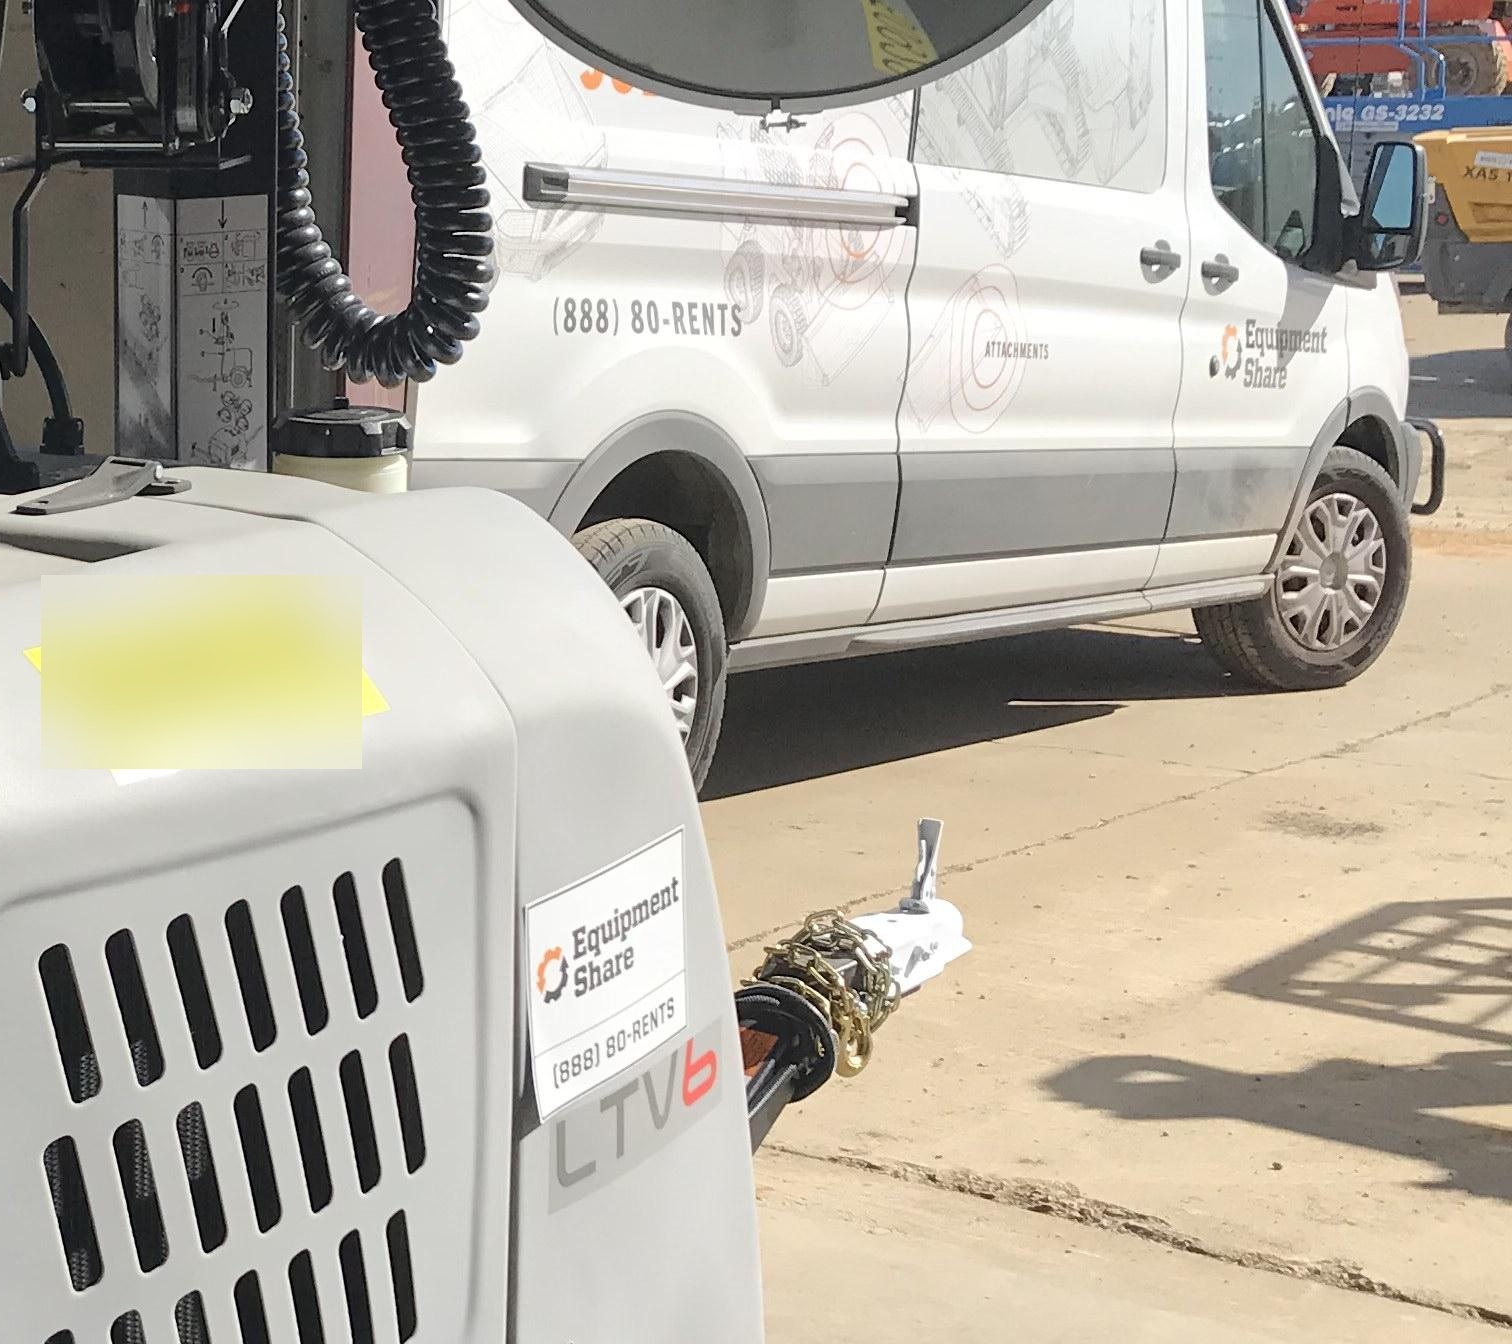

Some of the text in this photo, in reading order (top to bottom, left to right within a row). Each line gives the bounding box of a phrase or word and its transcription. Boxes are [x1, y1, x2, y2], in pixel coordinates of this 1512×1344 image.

[1361, 104, 1445, 122] GS-3232
[1463, 166, 1498, 181] XAS
[553, 296, 742, 337] (888) 80-RENTS
[984, 340, 1049, 360] ATTACHMENTS
[1245, 319, 1327, 358] Equipment
[1243, 357, 1287, 389] Share
[572, 876, 679, 959] Equipment
[574, 946, 634, 998] Share
[553, 997, 676, 1088] (888) 80-RENTS
[556, 1037, 718, 1188] LTV6
